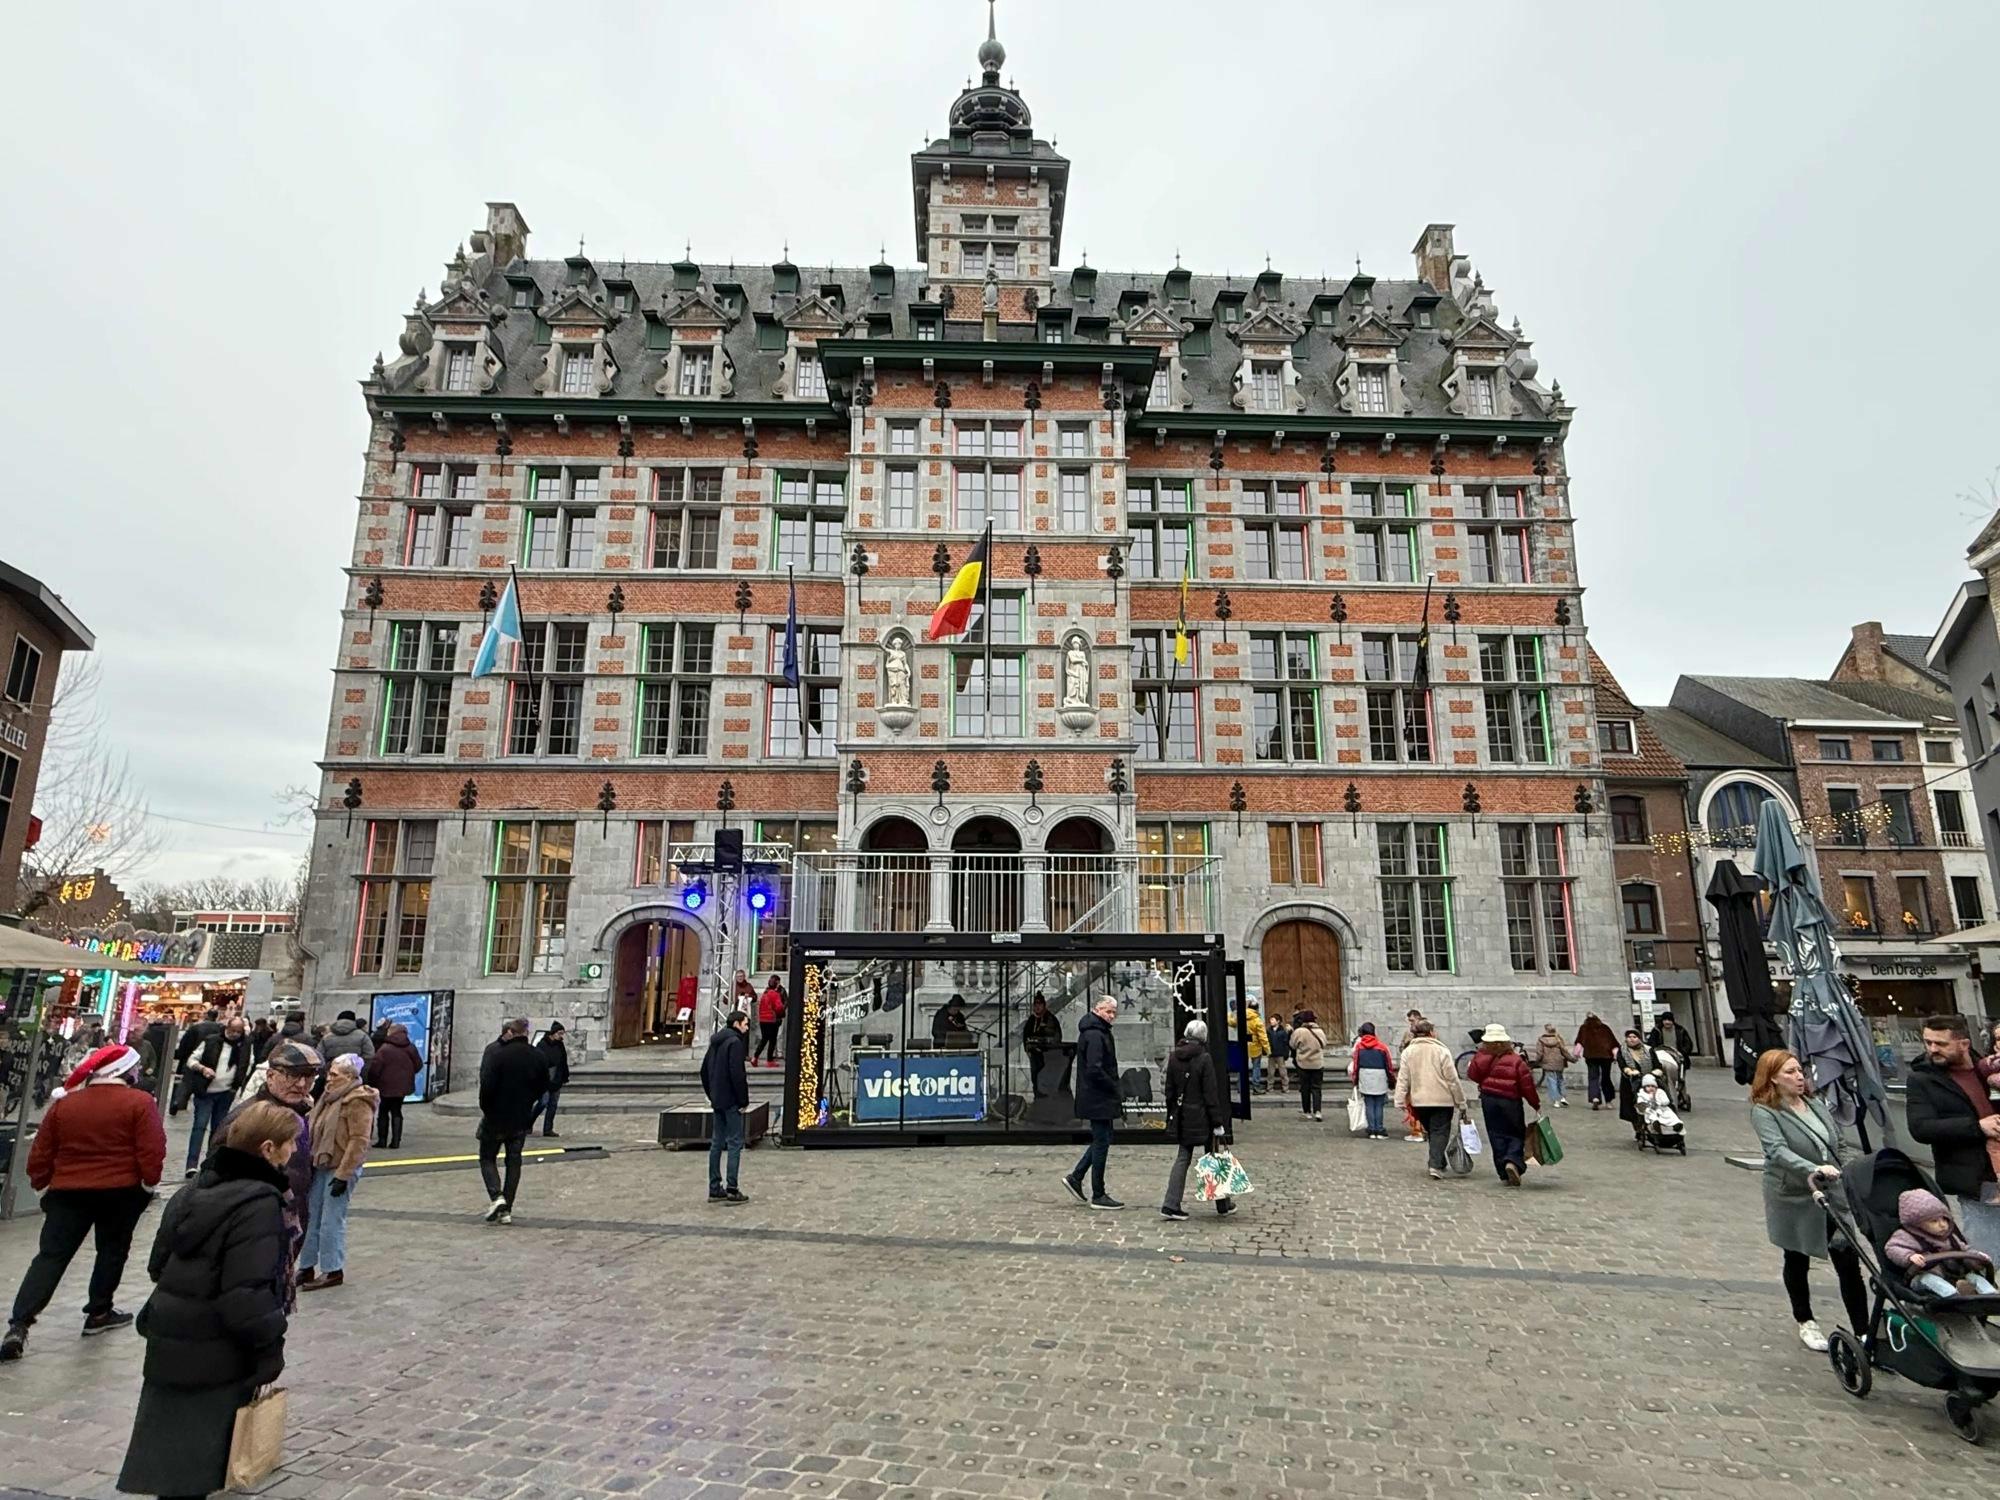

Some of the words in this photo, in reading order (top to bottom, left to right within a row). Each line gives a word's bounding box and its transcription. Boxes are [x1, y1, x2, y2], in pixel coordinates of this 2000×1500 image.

[1871, 963, 1894, 976] Den
[1895, 963, 1938, 978] Dragee
[864, 1068, 976, 1098] victoria
